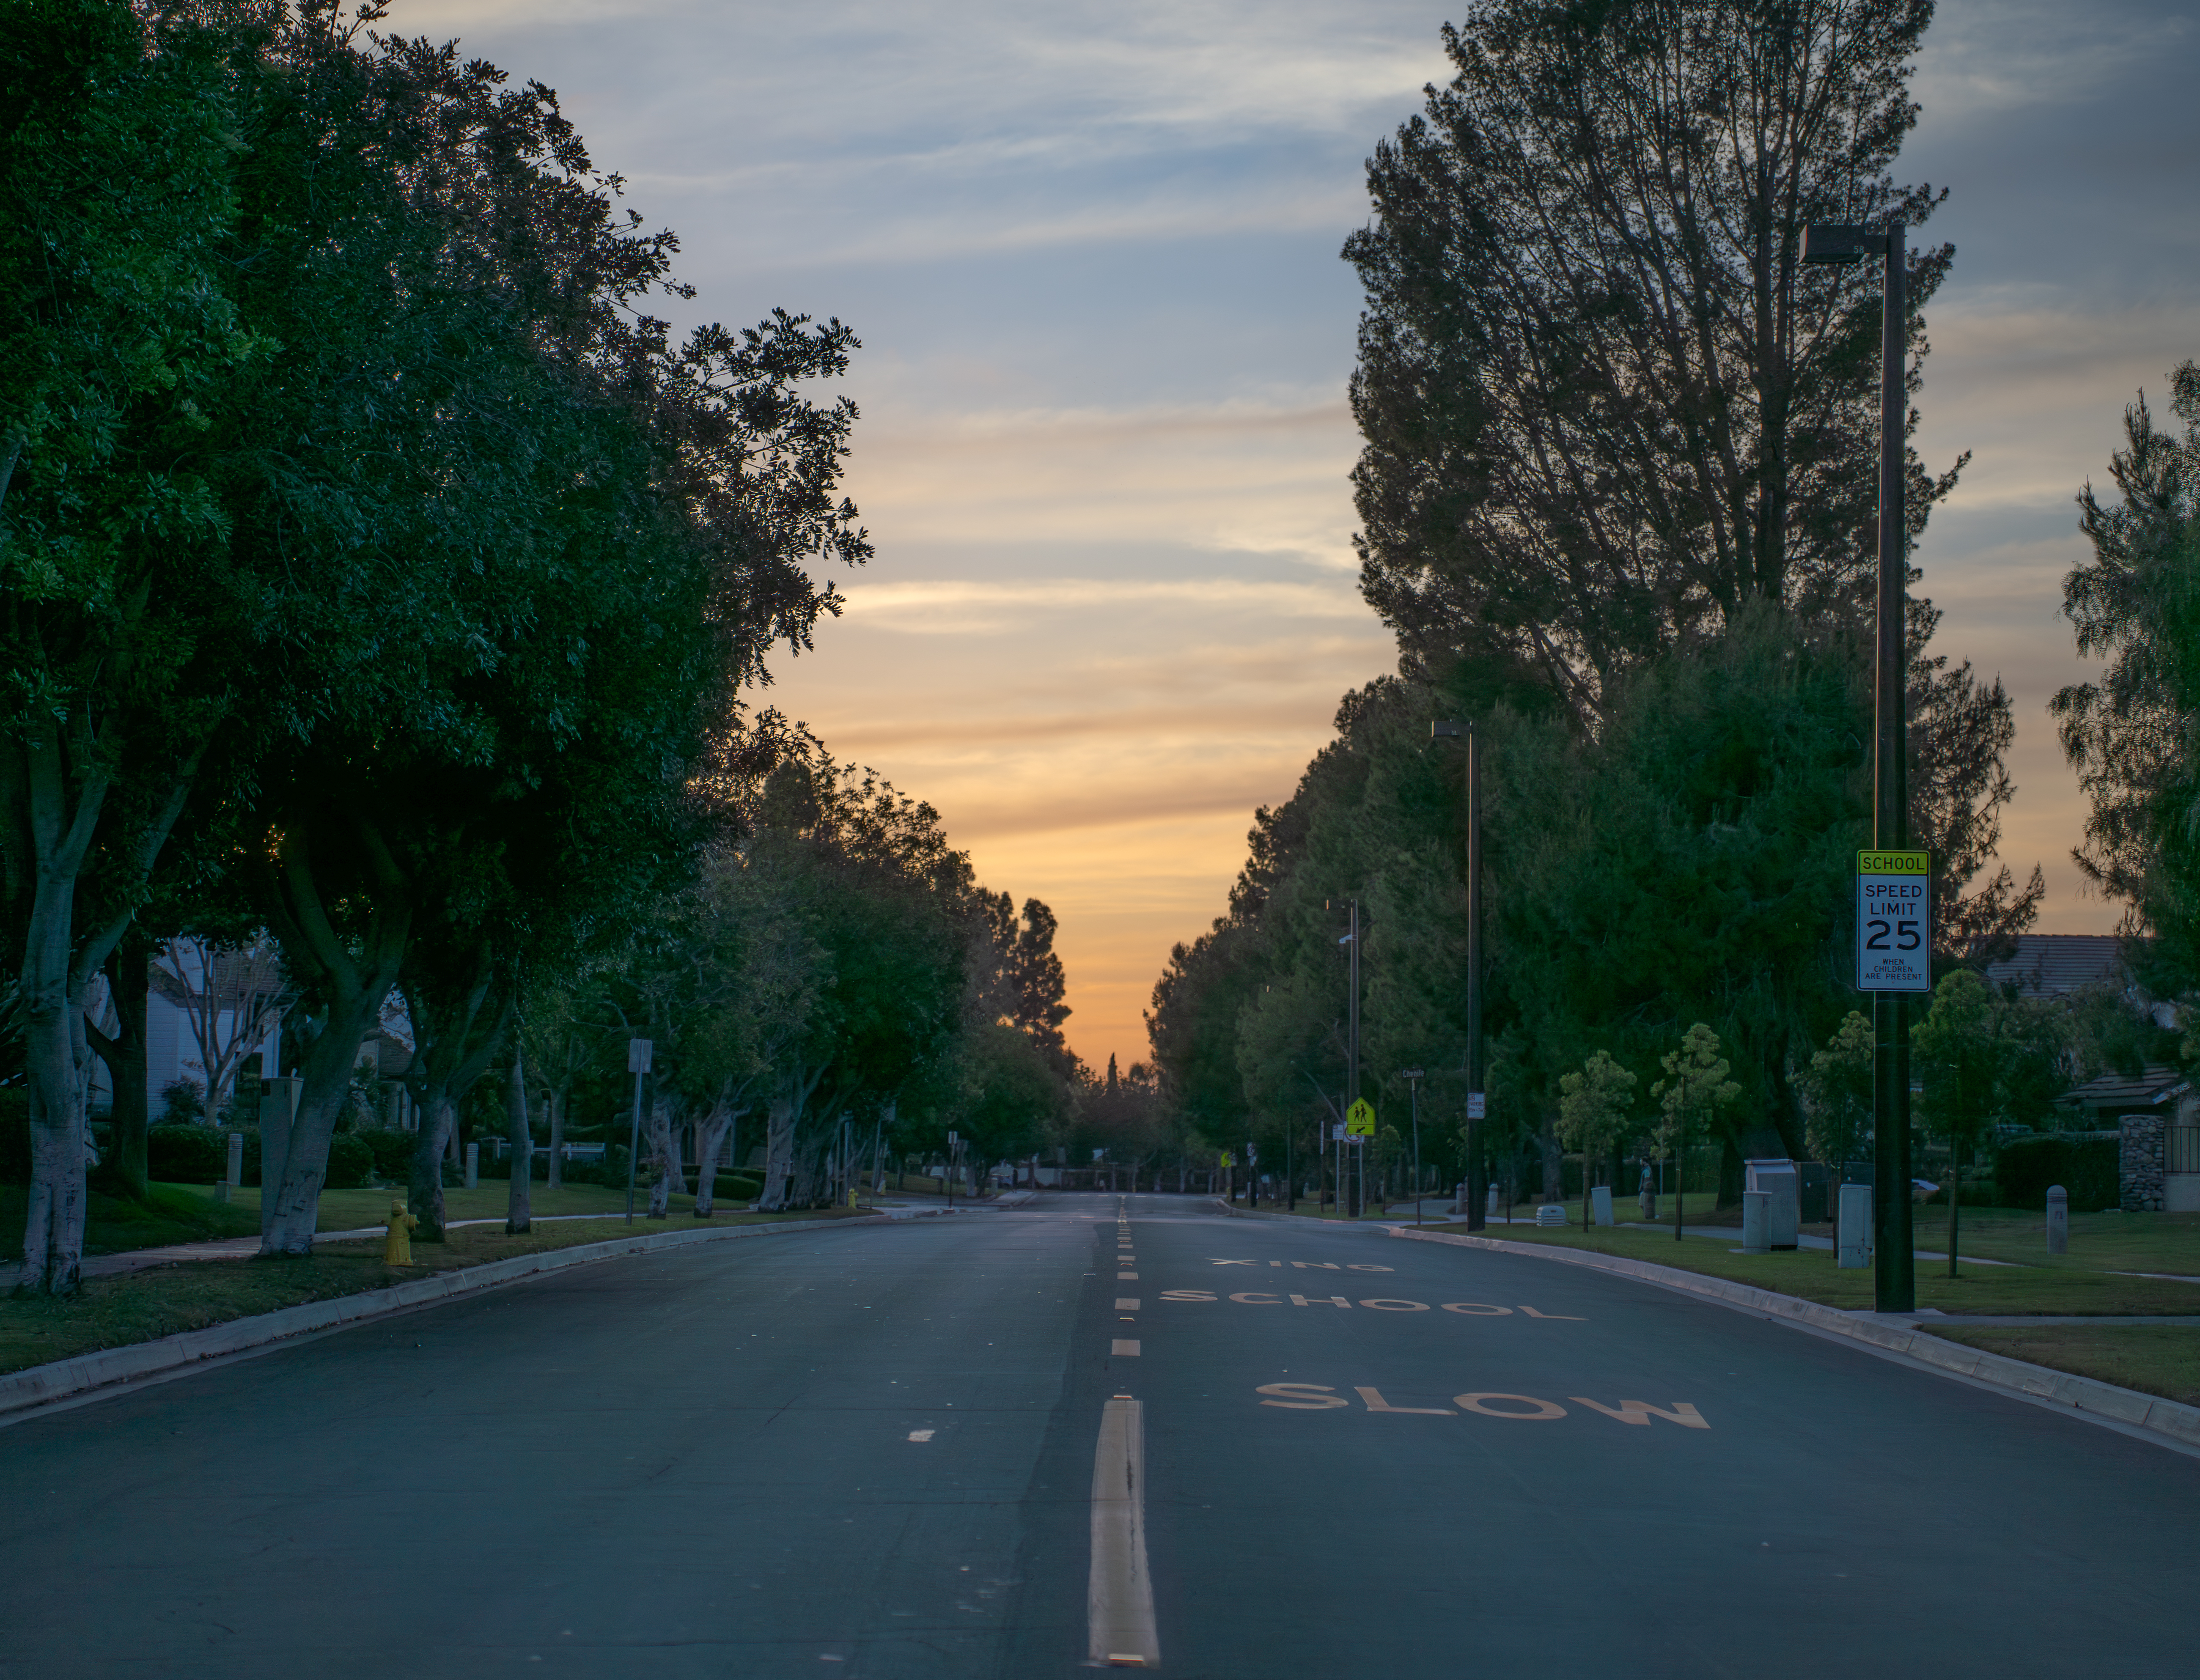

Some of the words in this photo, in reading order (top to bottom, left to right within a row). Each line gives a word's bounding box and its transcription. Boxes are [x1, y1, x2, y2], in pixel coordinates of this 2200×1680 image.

[1863, 857, 1925, 870] SCHOOL
[1865, 885, 1922, 898] SPEED
[1870, 903, 1917, 915] LIMIT
[1866, 920, 1921, 951] 25
[1205, 1257, 1395, 1271] XING
[1159, 1290, 1589, 1320] SCHOOL
[1255, 1383, 1711, 1429] SLOW
